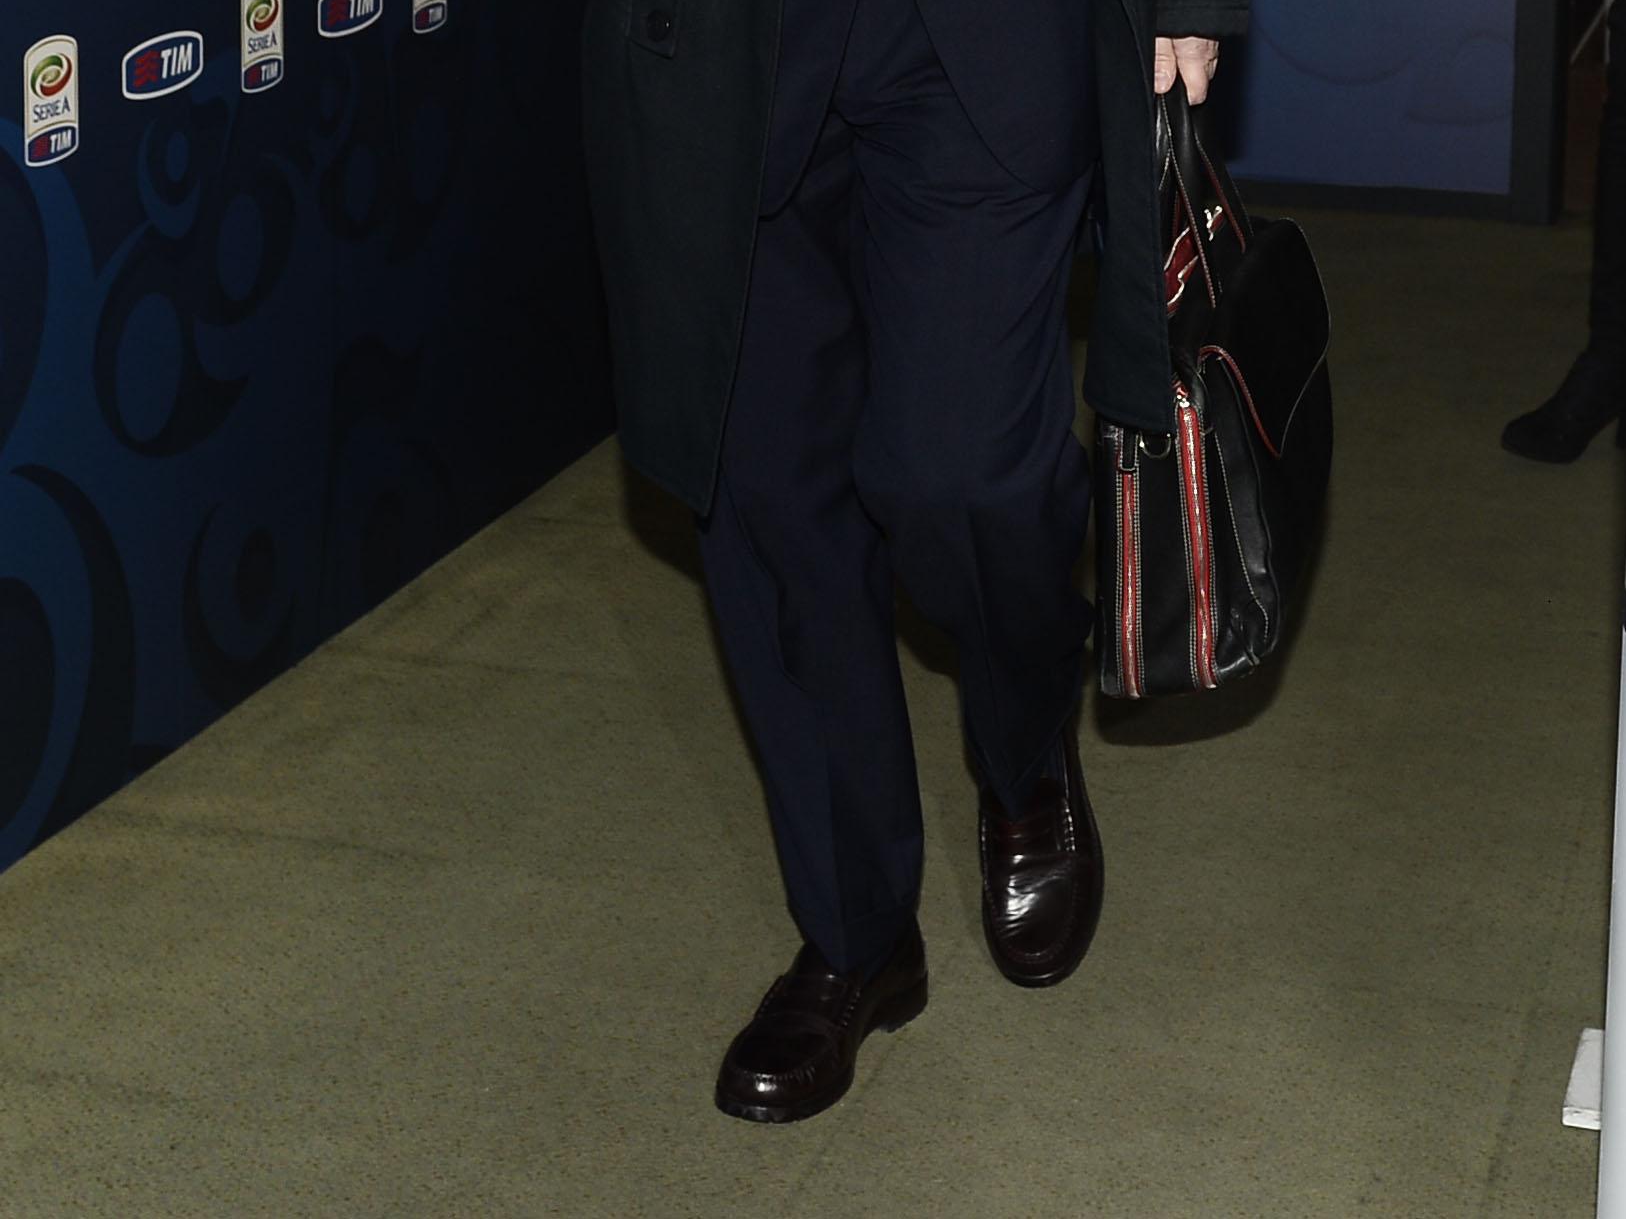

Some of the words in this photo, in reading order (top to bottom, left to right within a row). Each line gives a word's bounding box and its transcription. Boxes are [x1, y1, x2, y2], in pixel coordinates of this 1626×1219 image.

[248, 35, 269, 55] SERIE
[161, 42, 193, 79] TIM
[261, 61, 278, 82] TIM
[33, 100, 61, 123] SERIE
[50, 129, 72, 153] TIM
